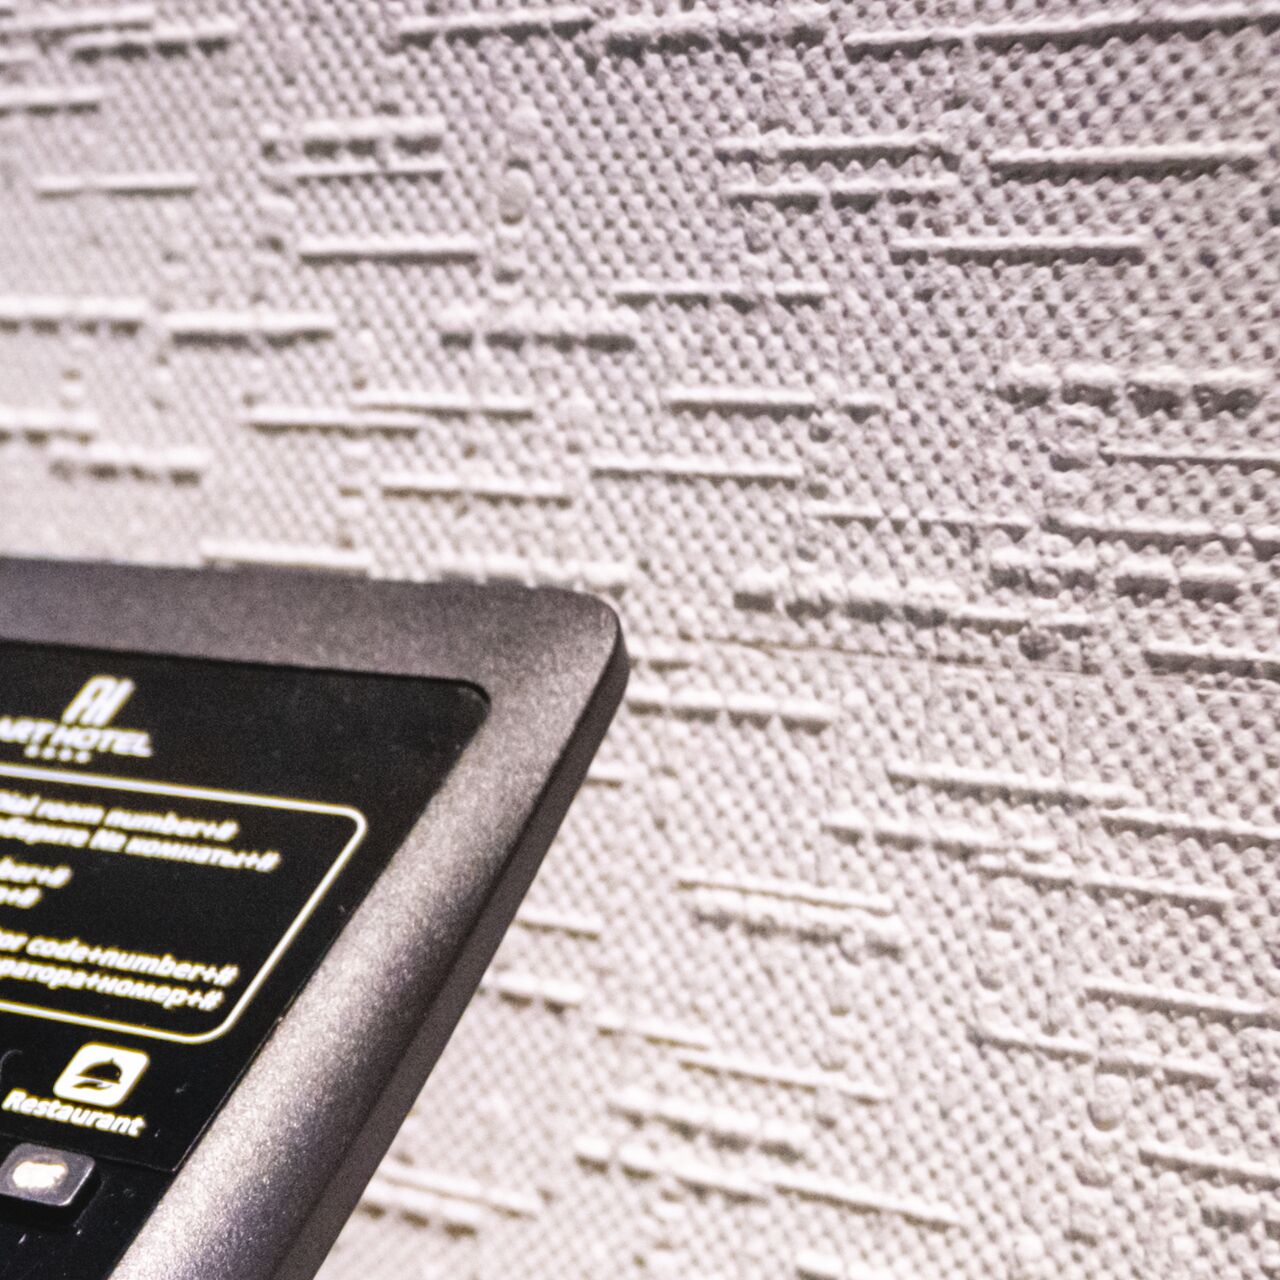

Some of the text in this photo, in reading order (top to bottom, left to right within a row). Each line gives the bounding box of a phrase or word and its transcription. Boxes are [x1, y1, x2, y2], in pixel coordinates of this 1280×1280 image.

[53, 723, 152, 757] HOTEL
[36, 799, 105, 826] room
[26, 936, 239, 988] code+number+#
[1, 1087, 147, 1138] Restaurant
